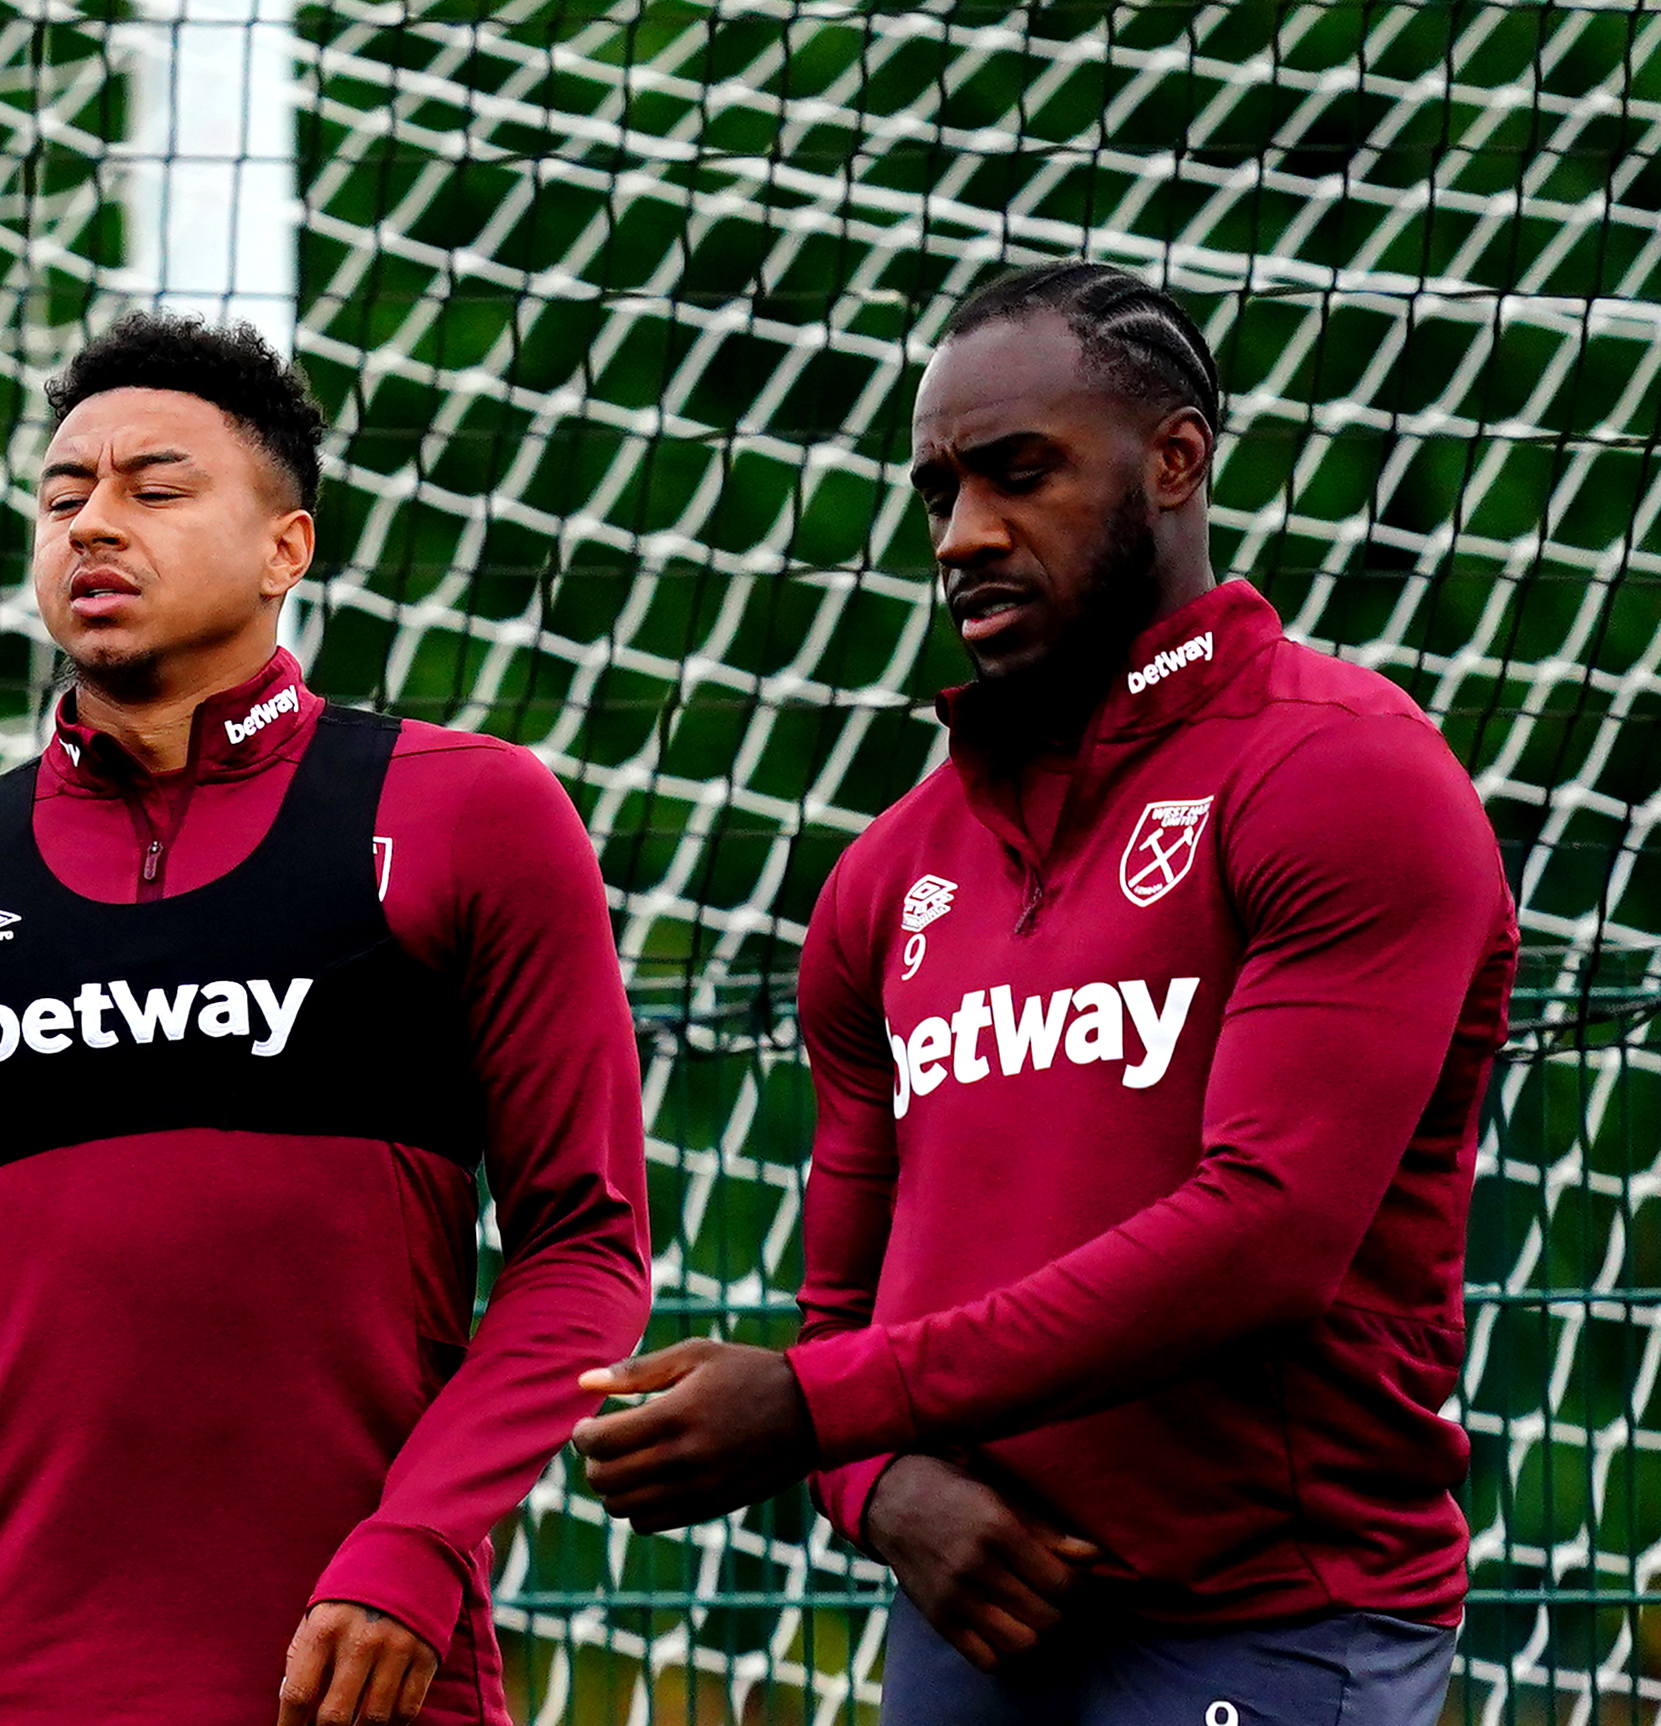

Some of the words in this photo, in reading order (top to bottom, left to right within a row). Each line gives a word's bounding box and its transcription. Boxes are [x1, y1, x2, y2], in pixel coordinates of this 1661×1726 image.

[1128, 631, 1213, 694] betway
[224, 684, 299, 745] betway
[901, 933, 926, 981] 9
[885, 977, 1201, 1120] betway
